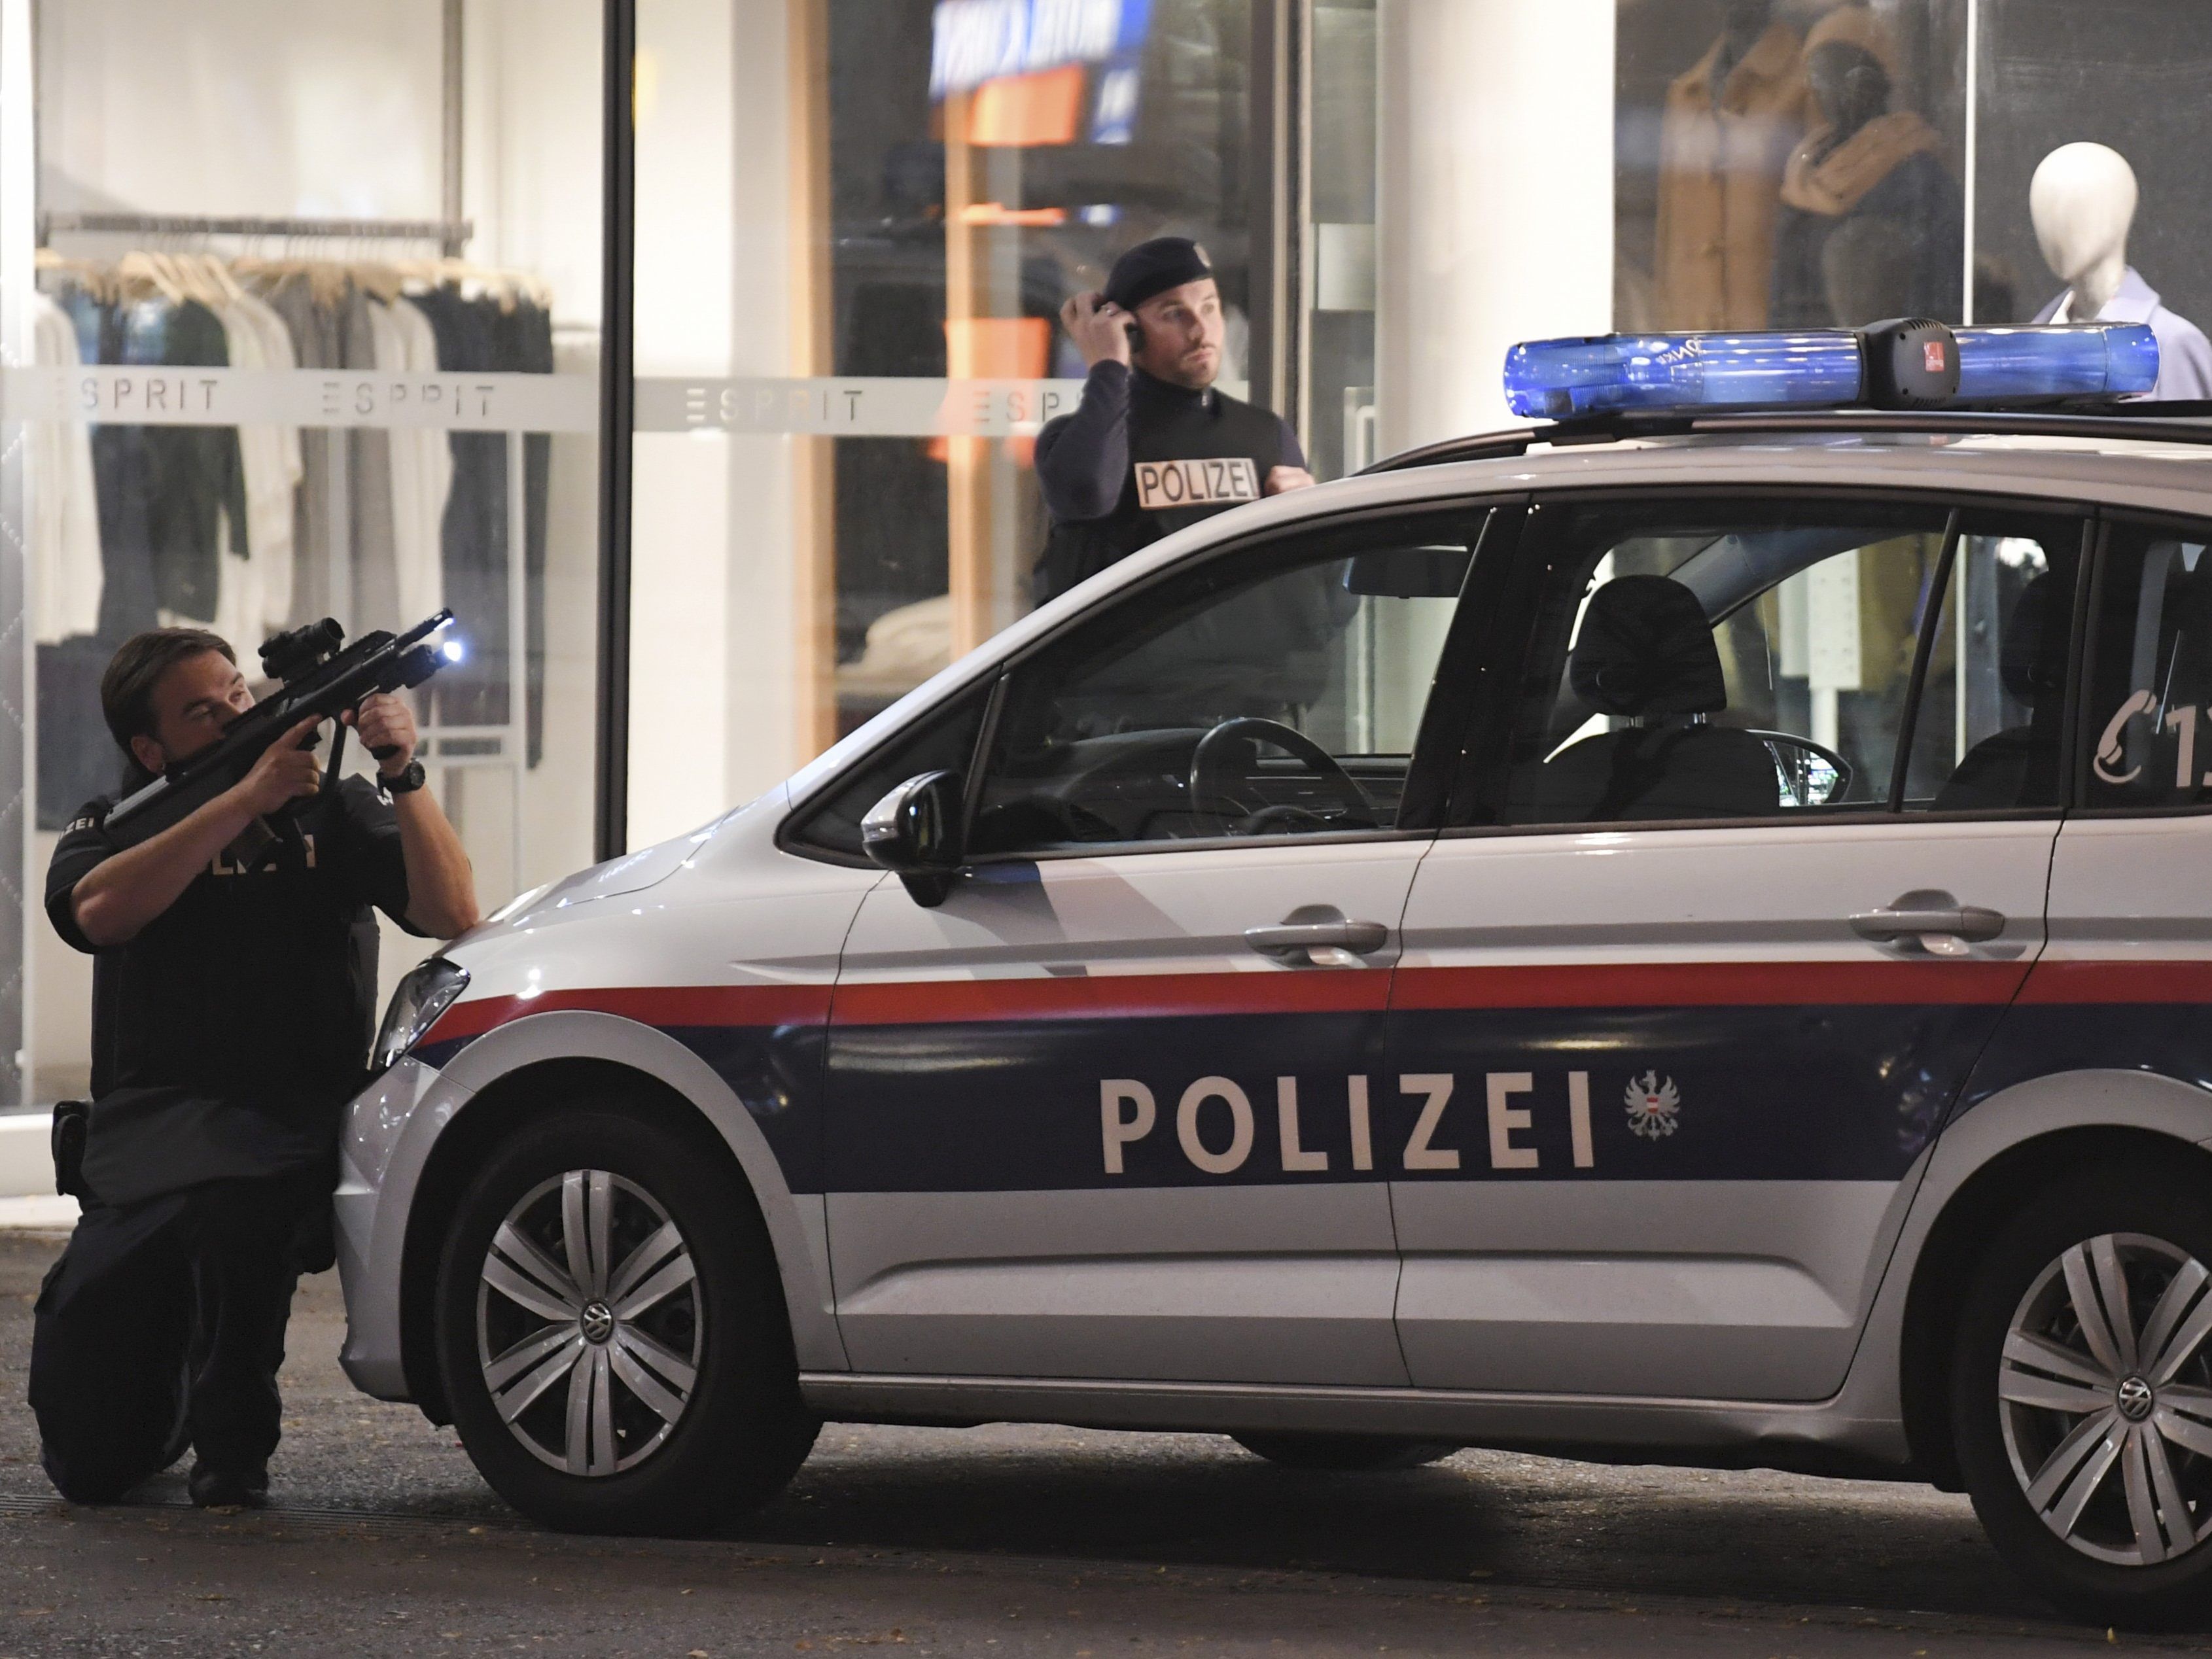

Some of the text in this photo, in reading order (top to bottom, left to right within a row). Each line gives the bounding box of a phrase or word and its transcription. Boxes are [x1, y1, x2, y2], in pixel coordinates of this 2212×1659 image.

[1140, 461, 1256, 504] POLIZEI
[2165, 705, 2212, 788] 1
[1100, 1071, 1594, 1174] POLIZEI
